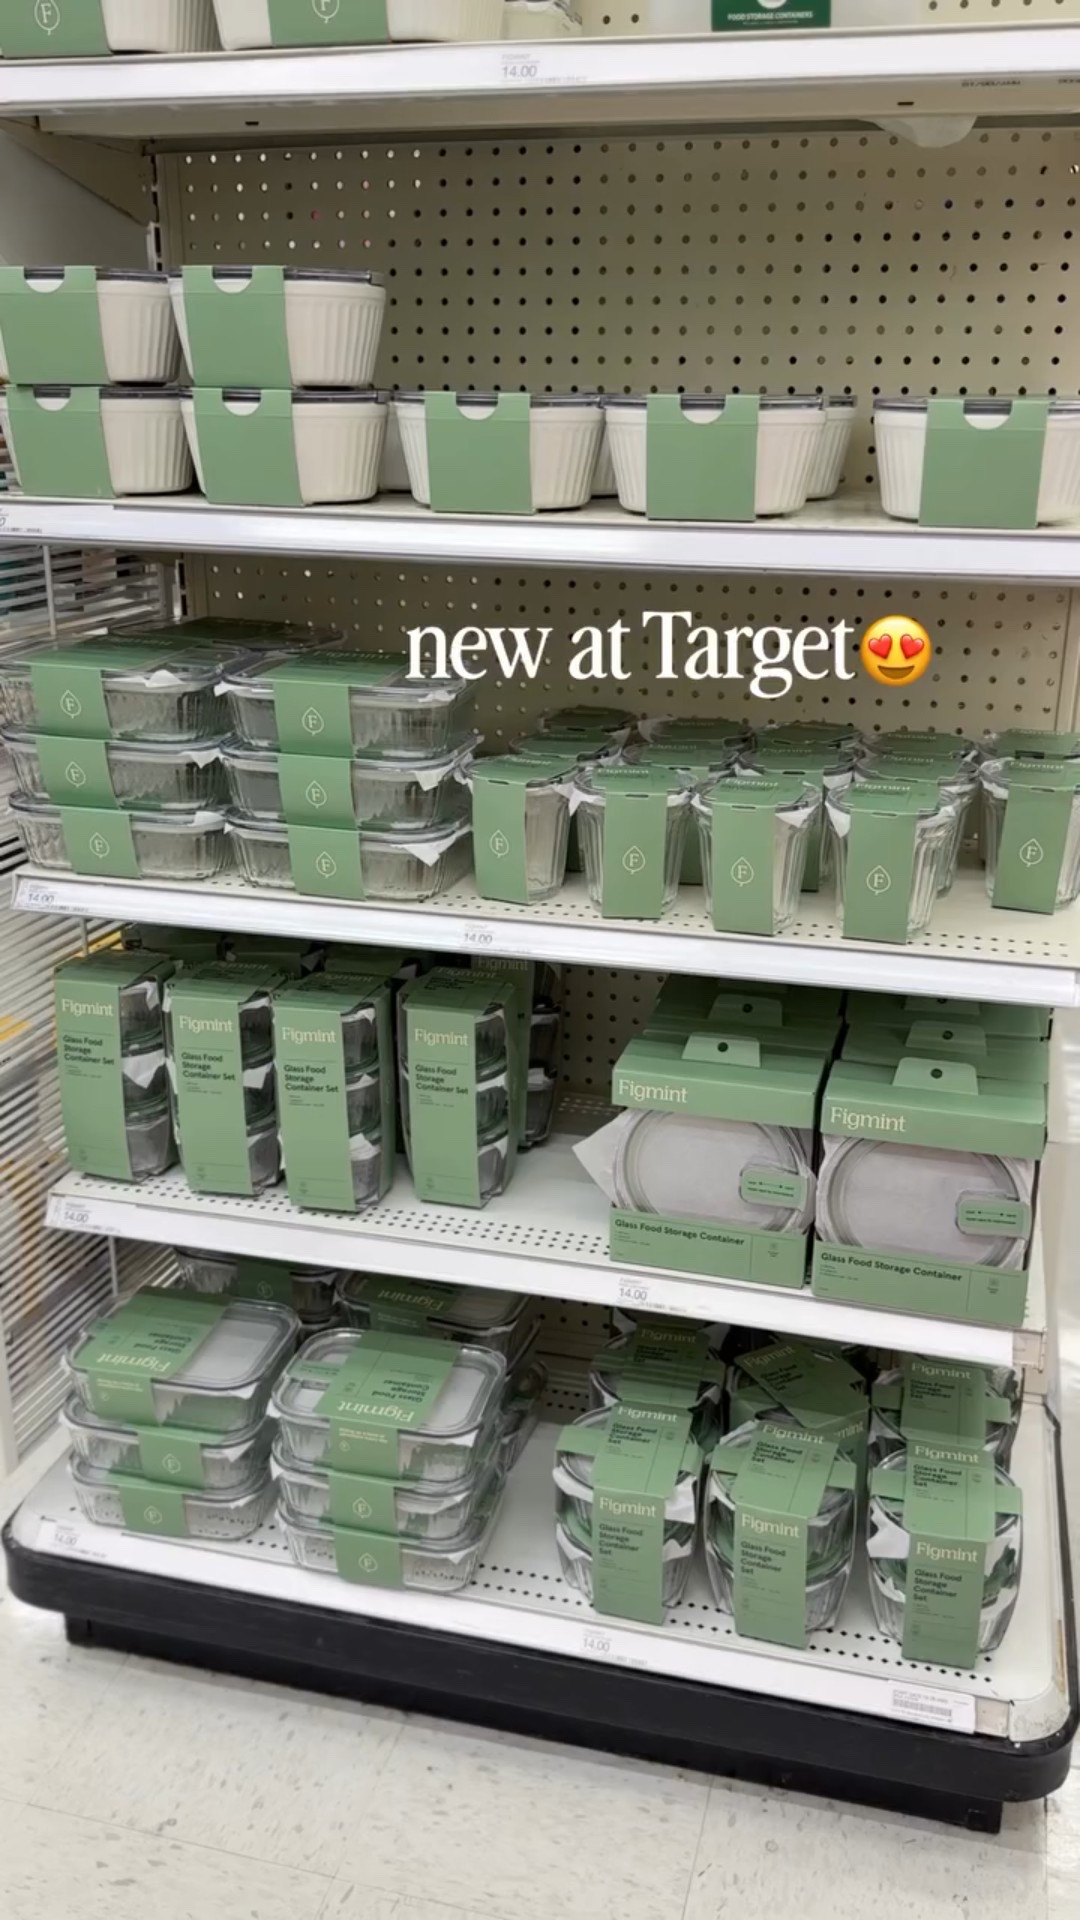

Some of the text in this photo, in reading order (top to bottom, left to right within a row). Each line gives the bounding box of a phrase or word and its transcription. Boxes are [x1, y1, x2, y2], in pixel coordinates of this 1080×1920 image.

[727, 10, 813, 21] FOOD STORAGE CONTAINERS
[501, 65, 538, 79] 14.00
[464, 932, 493, 945] 14.00
[62, 998, 114, 1017] Figmint
[180, 1015, 233, 1033] Figmint
[282, 1027, 336, 1044] Figmint
[415, 1028, 468, 1046] Figmint
[181, 1051, 223, 1062] Glass Food
[182, 1061, 211, 1071] Storage
[284, 1065, 326, 1074] Glass Food
[415, 1065, 456, 1075] Glass Food
[182, 1070, 235, 1081] Container Set
[285, 1074, 314, 1083] Storage
[416, 1073, 444, 1084] Storage
[285, 1083, 323, 1091] Container
[416, 1083, 468, 1095] Container Set
[618, 1079, 688, 1103] Figmint
[830, 1106, 906, 1132] Figmint
[615, 1219, 638, 1230] Glass
[640, 1222, 662, 1233] Food
[664, 1226, 698, 1239] Storage
[700, 1232, 745, 1245] Container
[821, 1252, 846, 1264] Glass
[848, 1255, 872, 1268] Food
[874, 1261, 911, 1274] Storage
[913, 1267, 963, 1281] Container
[619, 1287, 648, 1301] 14.00
[97, 1353, 171, 1372] Figmint
[911, 1362, 972, 1379] Figmint
[337, 1400, 415, 1422] Figmint
[618, 1405, 678, 1422] Figmint
[763, 1424, 824, 1444] Figmint
[915, 1445, 979, 1463] Figmint
[599, 1496, 656, 1517] Figmint
[741, 1513, 799, 1538] Figmint
[916, 1541, 978, 1562] Figmint
[914, 1569, 962, 1582] Glass Food
[914, 1577, 947, 1588] Storage
[913, 1585, 957, 1597] Container
[913, 1593, 927, 1601] Set
[584, 1638, 610, 1652] 14.00
